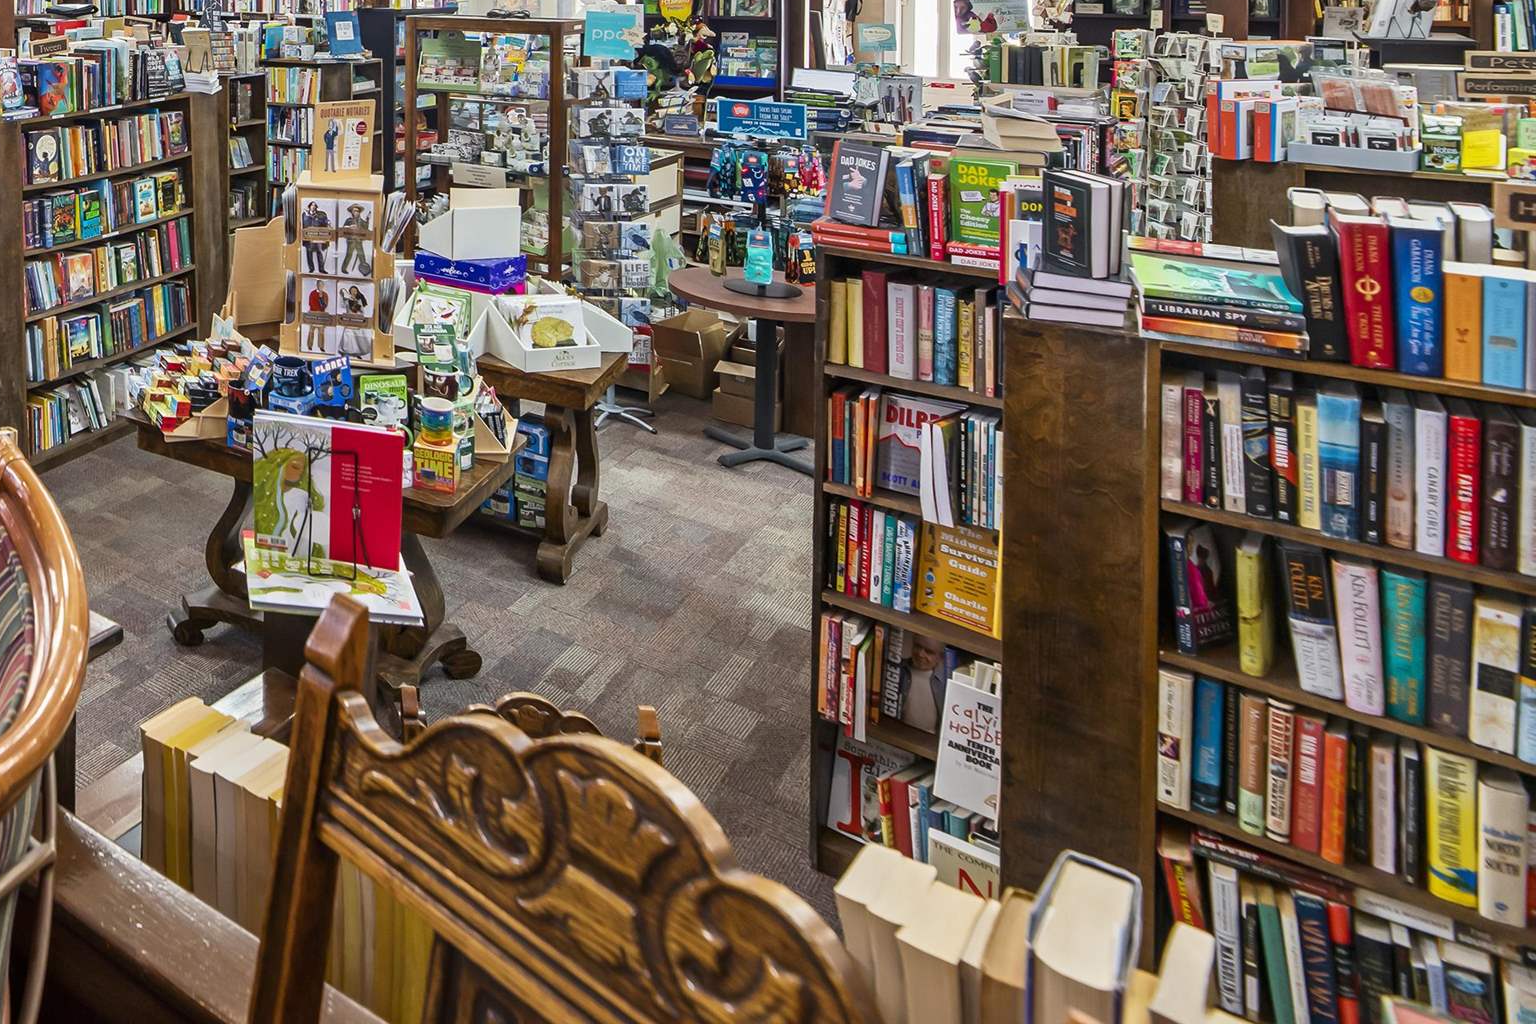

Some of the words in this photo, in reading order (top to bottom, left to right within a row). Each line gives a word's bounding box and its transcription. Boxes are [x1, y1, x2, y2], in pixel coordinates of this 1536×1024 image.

[39, 44, 62, 54] Tween
[320, 108, 345, 119] QUOTABLE
[346, 106, 370, 117] NOTABLES
[623, 156, 647, 164] LAKE
[624, 147, 646, 156] ON
[625, 163, 647, 172] TIME
[840, 156, 855, 166] DAD
[855, 158, 877, 171] JOKES
[958, 164, 988, 176] DAD
[931, 193, 939, 211] JOKES
[959, 213, 990, 225] Cheesy
[960, 219, 989, 229] Edition
[949, 247, 964, 255] DAD
[965, 249, 987, 257] JOKES
[1368, 234, 1378, 264] DIANA
[624, 263, 649, 273] LIFE
[961, 259, 977, 267] DAD
[1410, 239, 1422, 283] GABALDON
[1424, 249, 1434, 276] DIANA
[1305, 280, 1323, 320] AUTUMN
[1316, 276, 1331, 309] DRUMS
[1158, 304, 1221, 319] LIBRARIAN
[1225, 311, 1248, 323] SPY
[1224, 298, 1248, 306] DAVID
[1250, 300, 1291, 311] CANFORD
[1372, 305, 1382, 323] THE
[1358, 312, 1369, 339] CROSS
[1373, 326, 1384, 350] FIERY
[283, 368, 298, 378] TREK
[314, 357, 348, 375] PLANET
[365, 379, 406, 390] DINOSAUR
[389, 386, 406, 394] mug
[415, 447, 454, 463] GEOLOGIC
[1273, 426, 1289, 468] NUREMBERG
[415, 458, 454, 481] TIME
[1303, 472, 1314, 494] SASSY
[1425, 465, 1440, 506] CANARY
[1457, 472, 1473, 504] FATES
[1304, 496, 1314, 513] TREE
[886, 526, 894, 542] DAVE
[960, 526, 983, 541] The
[1425, 508, 1440, 538] GIRLS
[1456, 509, 1473, 552] TRAITORS
[885, 542, 894, 565] BARRY
[942, 532, 999, 558] Midwest
[940, 544, 998, 569] Survival
[948, 559, 988, 578] Guide
[1289, 561, 1310, 610] FOLLETT
[1307, 575, 1326, 600] KEN
[1349, 574, 1368, 598] KEN
[1396, 583, 1411, 609] KEN
[944, 592, 988, 612] Charlie
[944, 601, 986, 623] Berens
[1353, 601, 1371, 651] FOLLETT
[1434, 591, 1451, 642] FOLLETT
[1453, 607, 1465, 633] KEN
[1393, 610, 1413, 662] FOLLETT
[1433, 653, 1449, 697] GIANTS
[1451, 658, 1465, 683] FALL
[884, 664, 901, 719] GEORGE
[977, 702, 994, 714] THE
[947, 740, 1000, 766] ANNIVERSA
[966, 739, 996, 756] TENTH
[1300, 734, 1317, 755] MARK
[965, 755, 993, 771] BOOK
[1299, 756, 1317, 785] HELPRIN
[933, 841, 955, 856] THE
[958, 854, 1000, 875] COMPL
[1484, 856, 1522, 879] SOUTH
